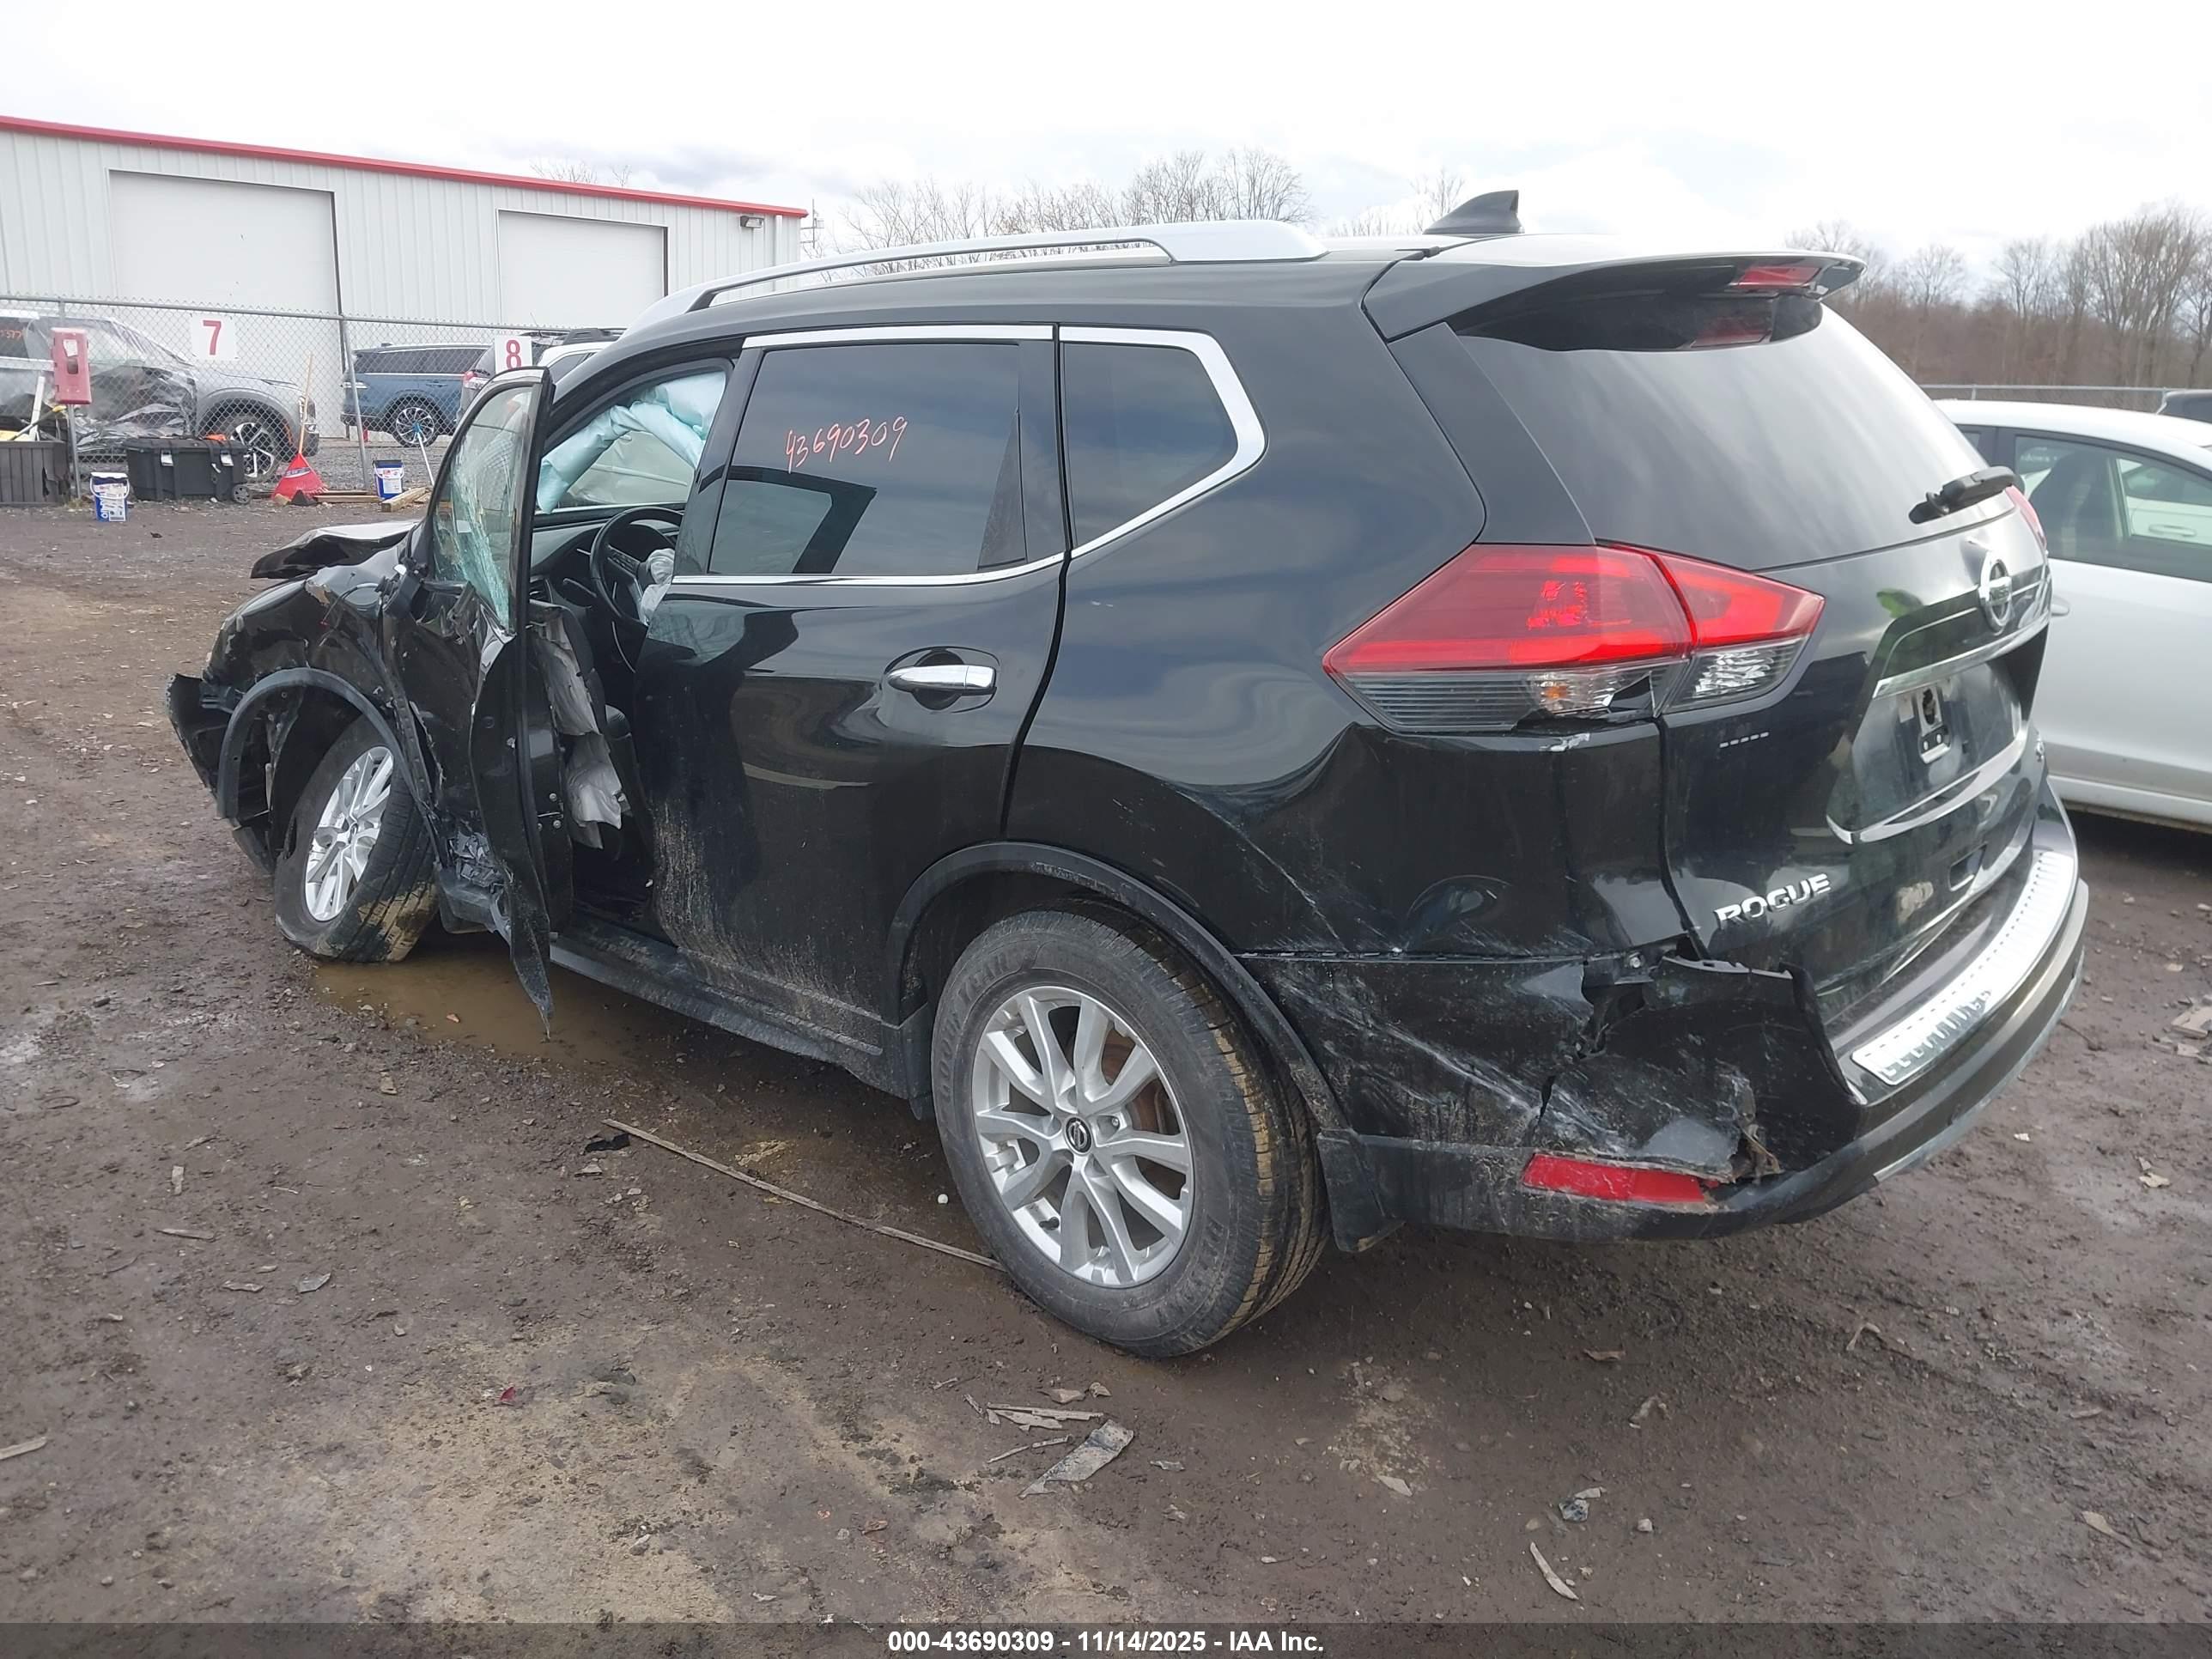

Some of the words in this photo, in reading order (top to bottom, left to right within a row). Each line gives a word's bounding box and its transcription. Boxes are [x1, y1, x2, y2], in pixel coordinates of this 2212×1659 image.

[203, 319, 222, 356] 7
[506, 339, 522, 369] 8
[785, 416, 908, 474] 43690309
[1713, 872, 1832, 931] ROGUE
